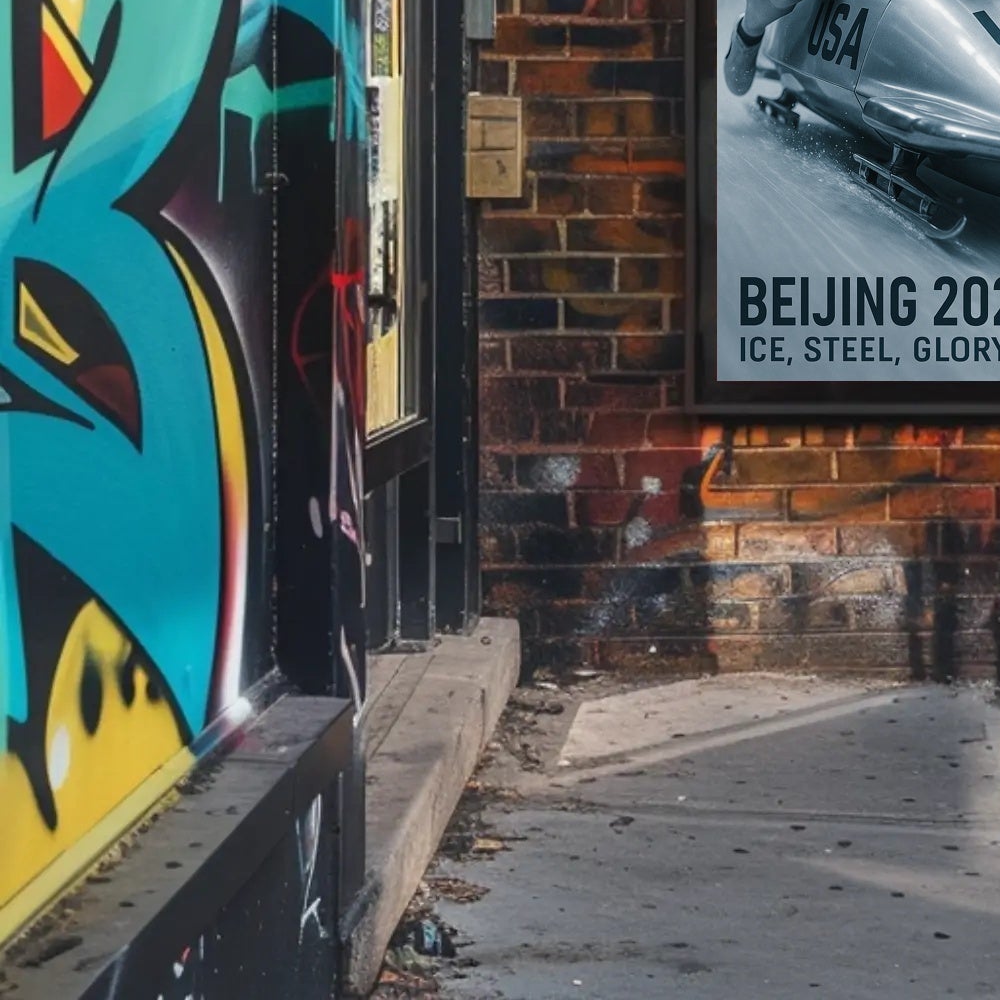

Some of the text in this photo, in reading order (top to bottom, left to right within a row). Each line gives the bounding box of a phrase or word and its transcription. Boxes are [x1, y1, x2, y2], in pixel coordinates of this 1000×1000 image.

[807, 0, 869, 71] USA
[740, 276, 917, 327] BEIJING
[740, 337, 794, 366] ICE,
[804, 336, 902, 366] STEEL,
